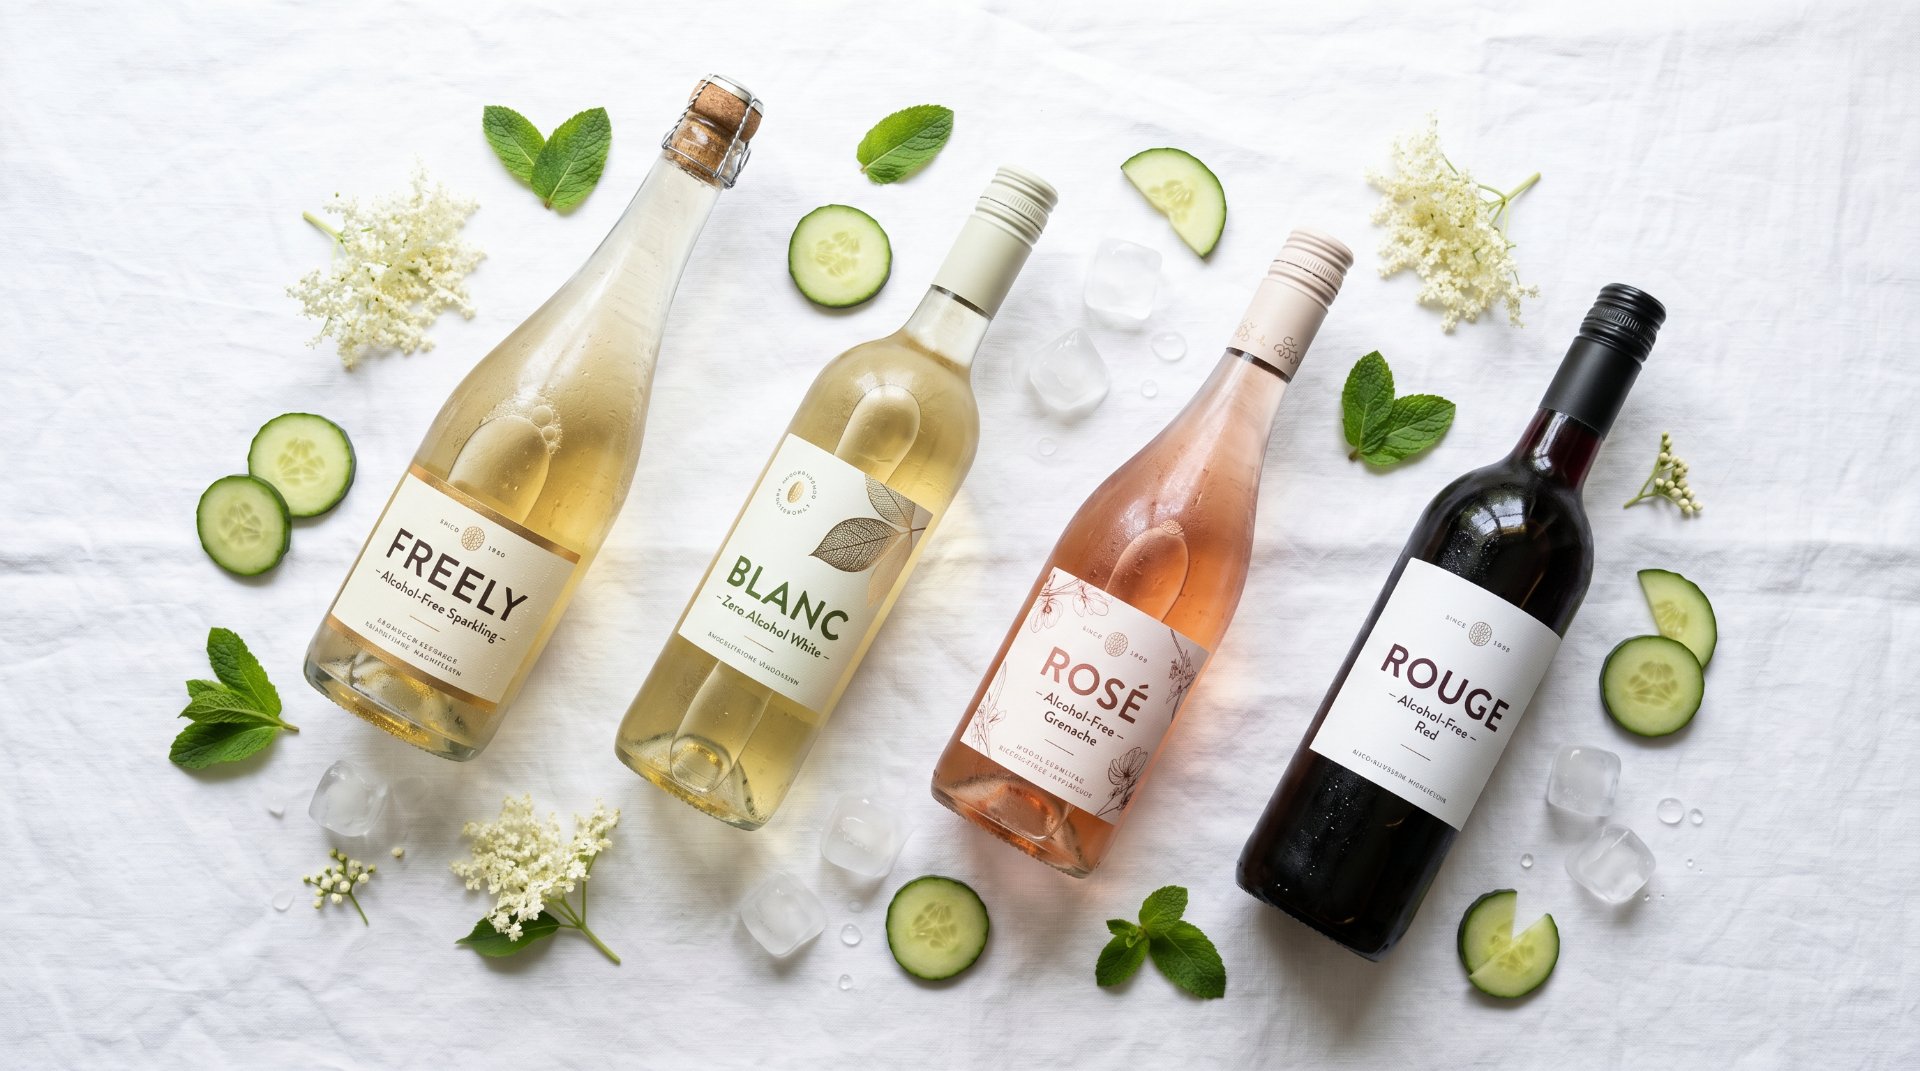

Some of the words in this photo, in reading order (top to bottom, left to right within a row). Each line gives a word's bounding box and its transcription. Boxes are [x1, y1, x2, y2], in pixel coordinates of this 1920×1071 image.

[381, 571, 445, 614] Alcohol-Free
[447, 608, 498, 644] Sparkling
[386, 528, 528, 621] FREELY
[727, 556, 849, 641] BLANC
[721, 595, 744, 618] Zero
[745, 611, 789, 640] Alcohol
[791, 633, 821, 658] White
[1041, 647, 1148, 724] ROSÉ
[1044, 693, 1114, 737] Alcohol-Free
[1381, 644, 1510, 733] ROUGE
[1398, 695, 1468, 738] Alcohol-Free
[1045, 711, 1096, 746] Grenache
[1415, 721, 1439, 740] Red
